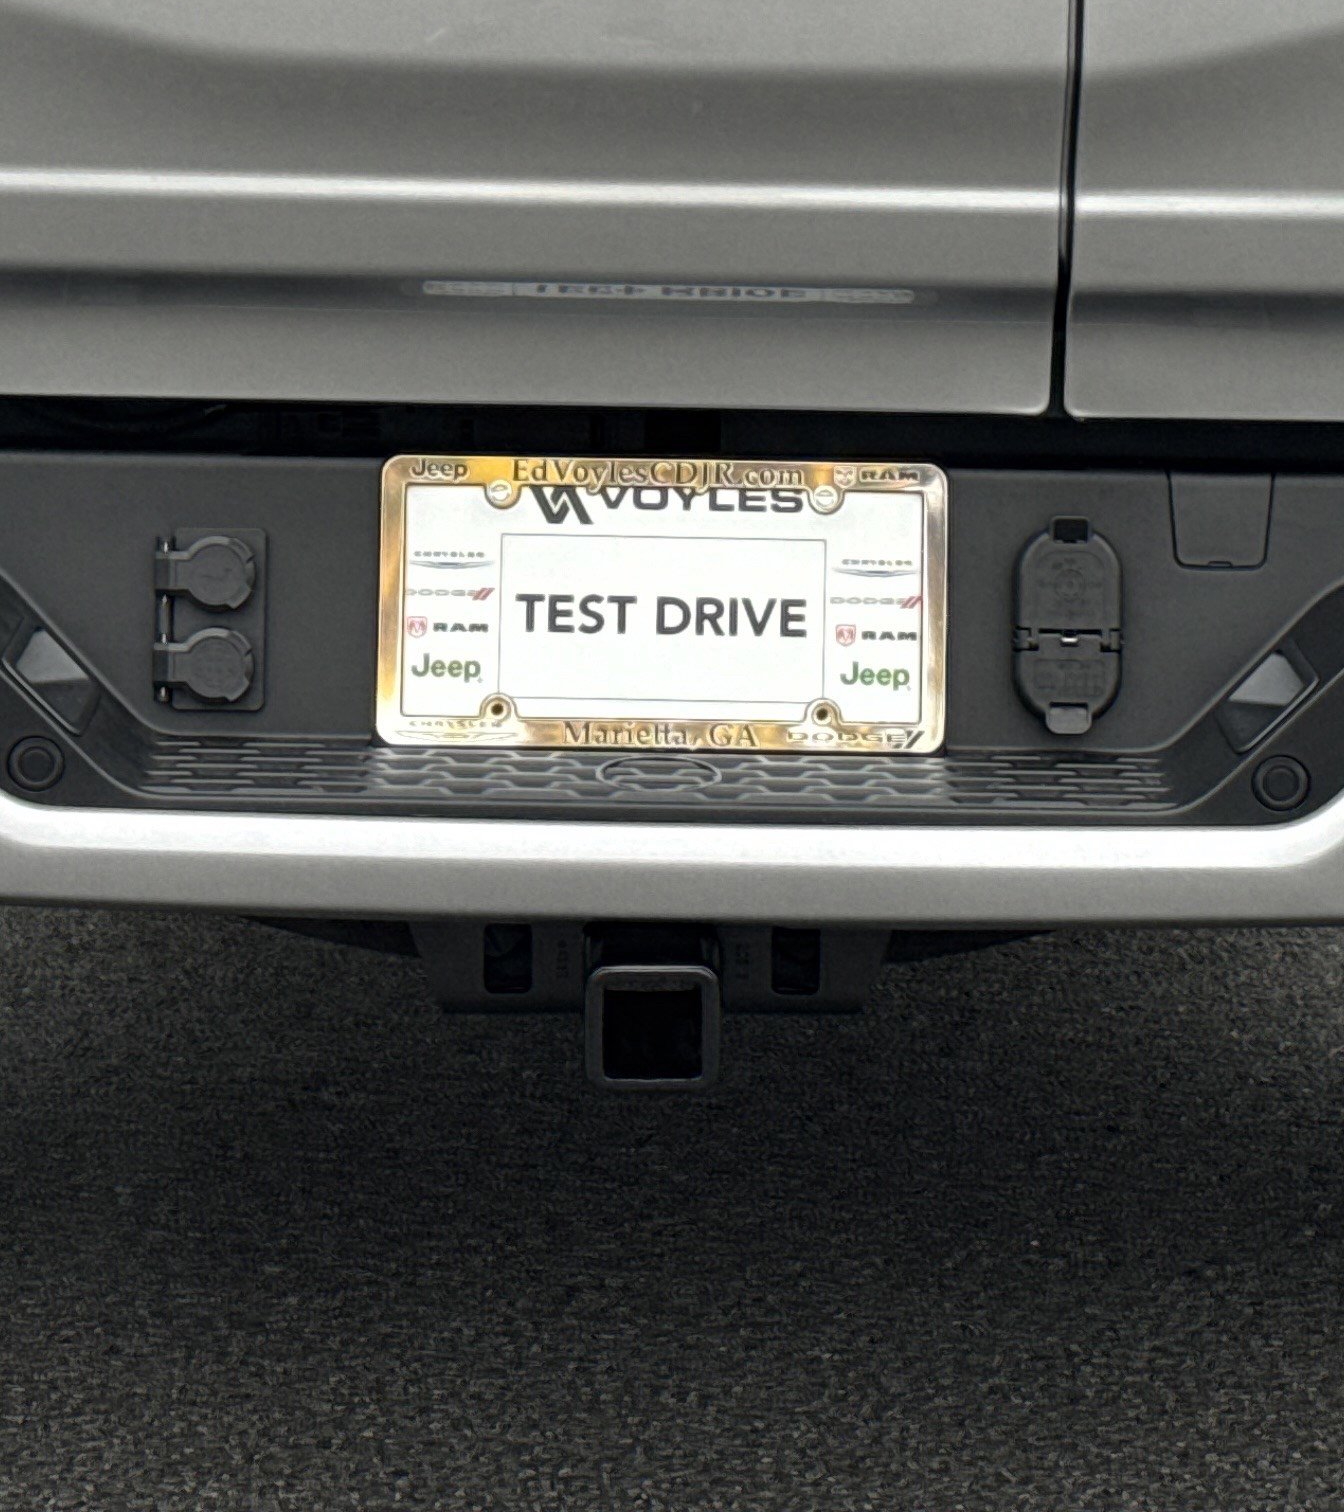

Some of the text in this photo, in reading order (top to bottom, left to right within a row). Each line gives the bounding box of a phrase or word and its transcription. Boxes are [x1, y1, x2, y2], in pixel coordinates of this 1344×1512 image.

[411, 459, 469, 479] Jeep
[859, 469, 920, 482] RAM
[602, 487, 804, 514] VOYLES
[515, 593, 807, 638] TEST DRIVE
[432, 622, 489, 633] RAM
[861, 630, 918, 641] RAM
[411, 653, 482, 683] Jeep
[840, 661, 910, 691] Jeep
[708, 722, 758, 747] GA
[787, 730, 906, 743] DODGE
